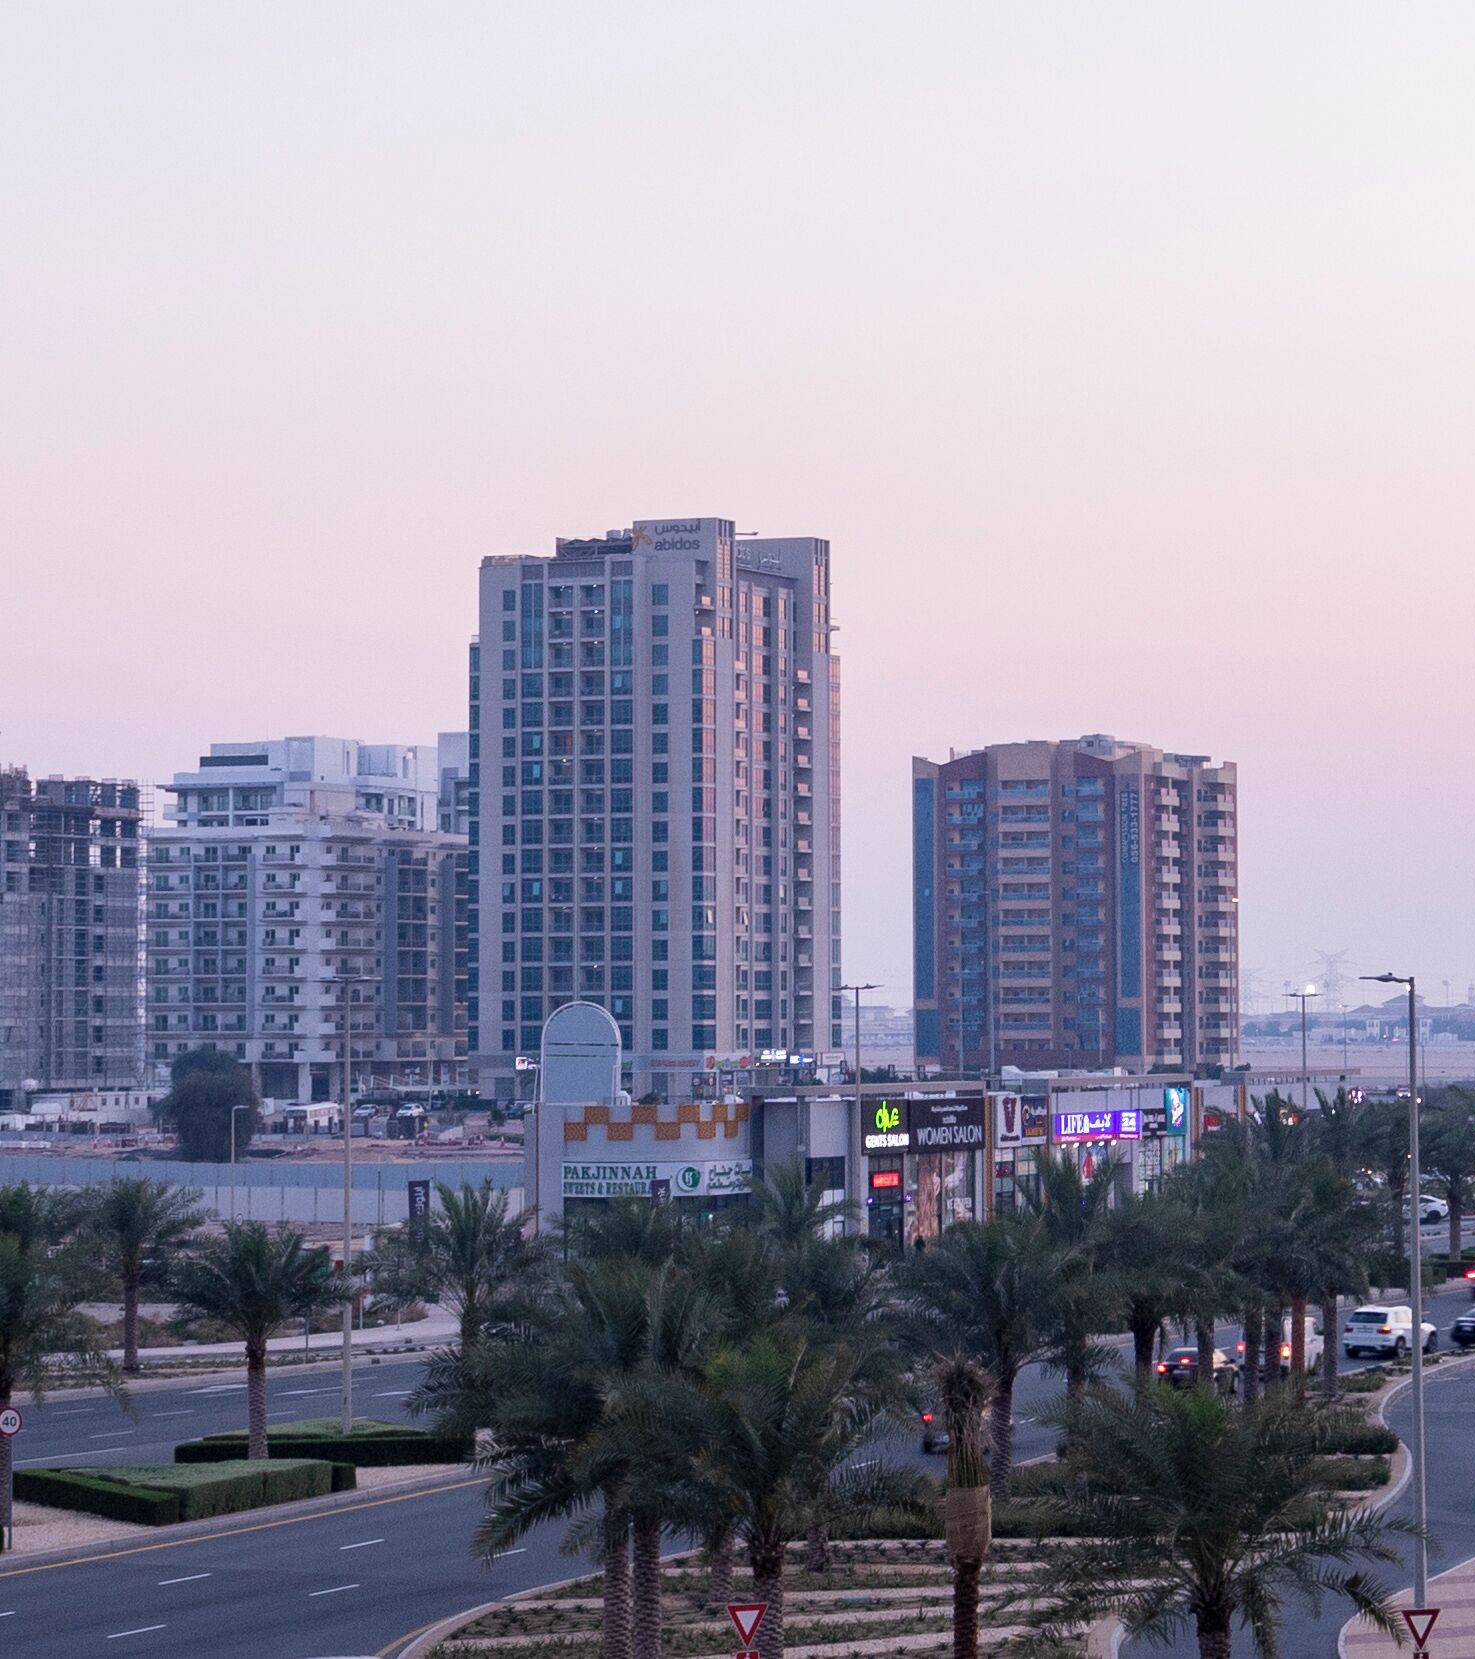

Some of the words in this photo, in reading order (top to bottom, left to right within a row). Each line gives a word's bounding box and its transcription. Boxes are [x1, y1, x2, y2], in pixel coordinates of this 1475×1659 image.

[655, 536, 700, 551] abidos
[1130, 792, 1138, 863] 056-533-1777
[1061, 1113, 1083, 1134] LIFE
[1121, 1117, 1136, 1127] 24
[887, 1133, 909, 1147] SALON
[917, 1126, 953, 1146] WOMEN
[953, 1125, 982, 1143] SALON
[563, 1165, 657, 1180] PAKJINNAH
[563, 1181, 595, 1195] SWEETS
[597, 1181, 605, 1194] &
[2, 1416, 17, 1427] 40
